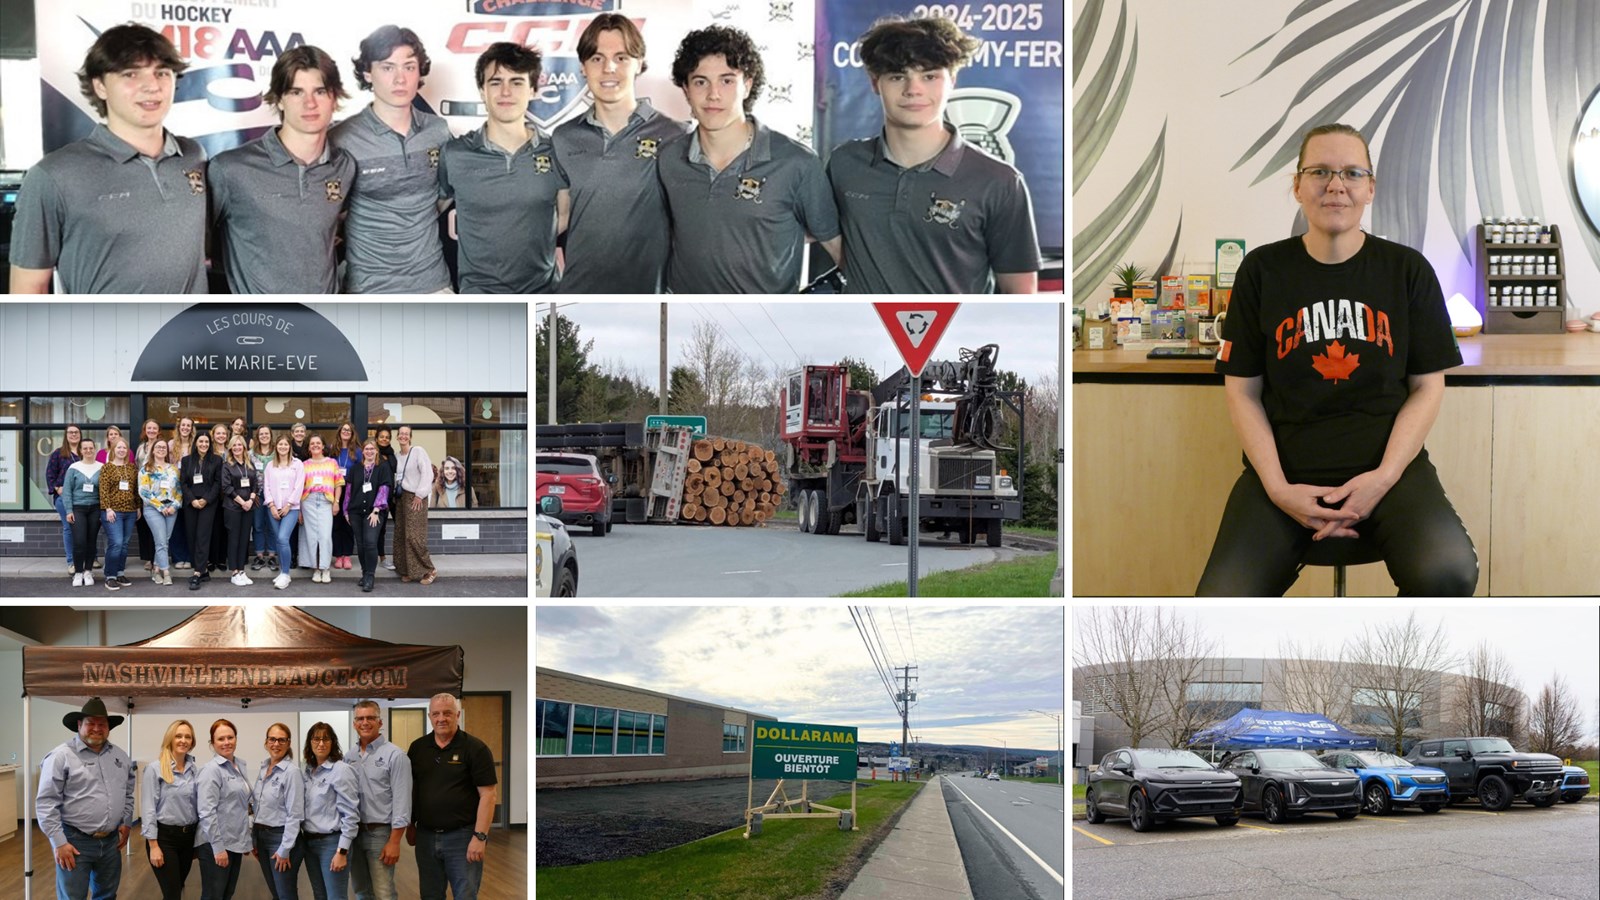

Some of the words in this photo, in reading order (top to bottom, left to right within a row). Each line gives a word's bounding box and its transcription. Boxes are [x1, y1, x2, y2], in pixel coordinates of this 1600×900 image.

[161, 4, 232, 23] HOCKEY
[206, 316, 231, 335] LES
[232, 312, 274, 327] COURS
[275, 318, 294, 335] DE
[1275, 299, 1394, 360] CANADA
[181, 355, 219, 370] MME
[225, 355, 318, 370] MARIE-EVE
[83, 664, 407, 689] NASHVILLEENBEAUCE.COM
[756, 726, 855, 744] DOLLARAMA
[774, 753, 840, 765] OUVERTURE
